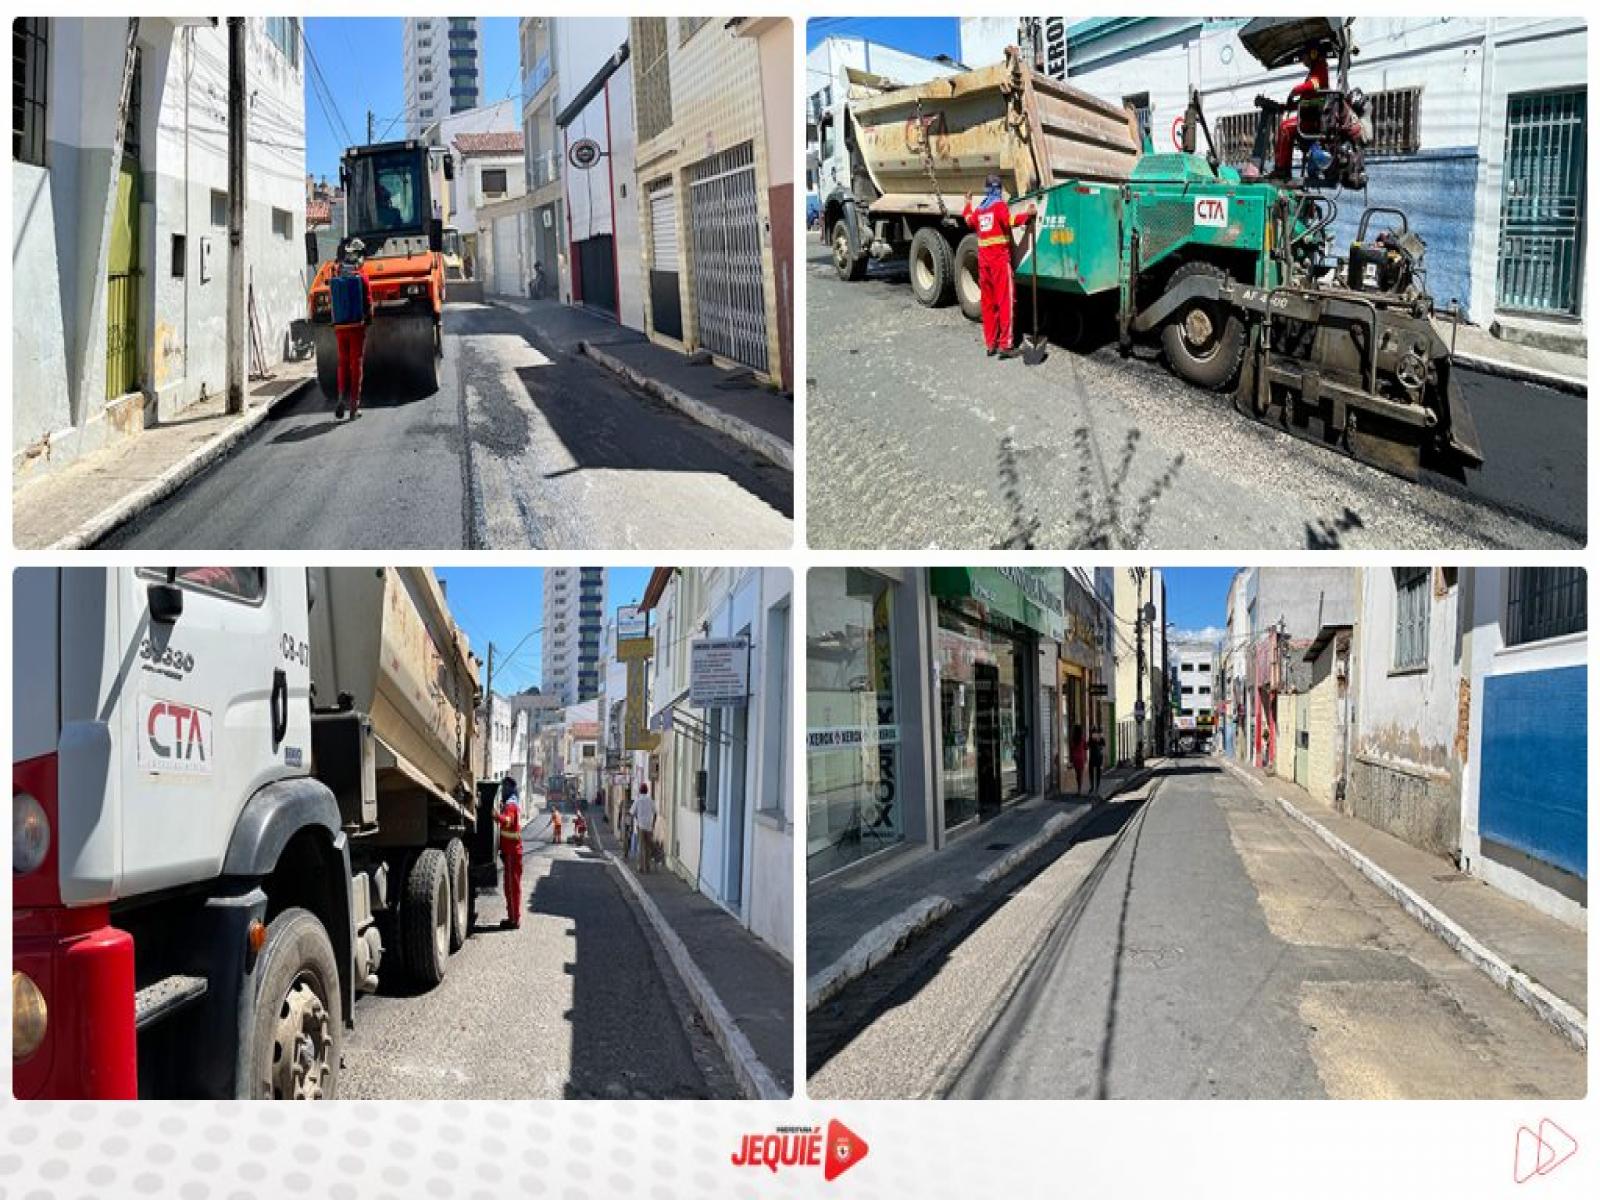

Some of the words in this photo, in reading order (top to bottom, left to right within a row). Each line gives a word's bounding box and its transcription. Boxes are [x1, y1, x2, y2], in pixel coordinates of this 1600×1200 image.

[1197, 200, 1225, 219] CTA
[147, 702, 205, 761] CTA
[809, 730, 834, 746] XEROX
[842, 730, 862, 743] XEROX
